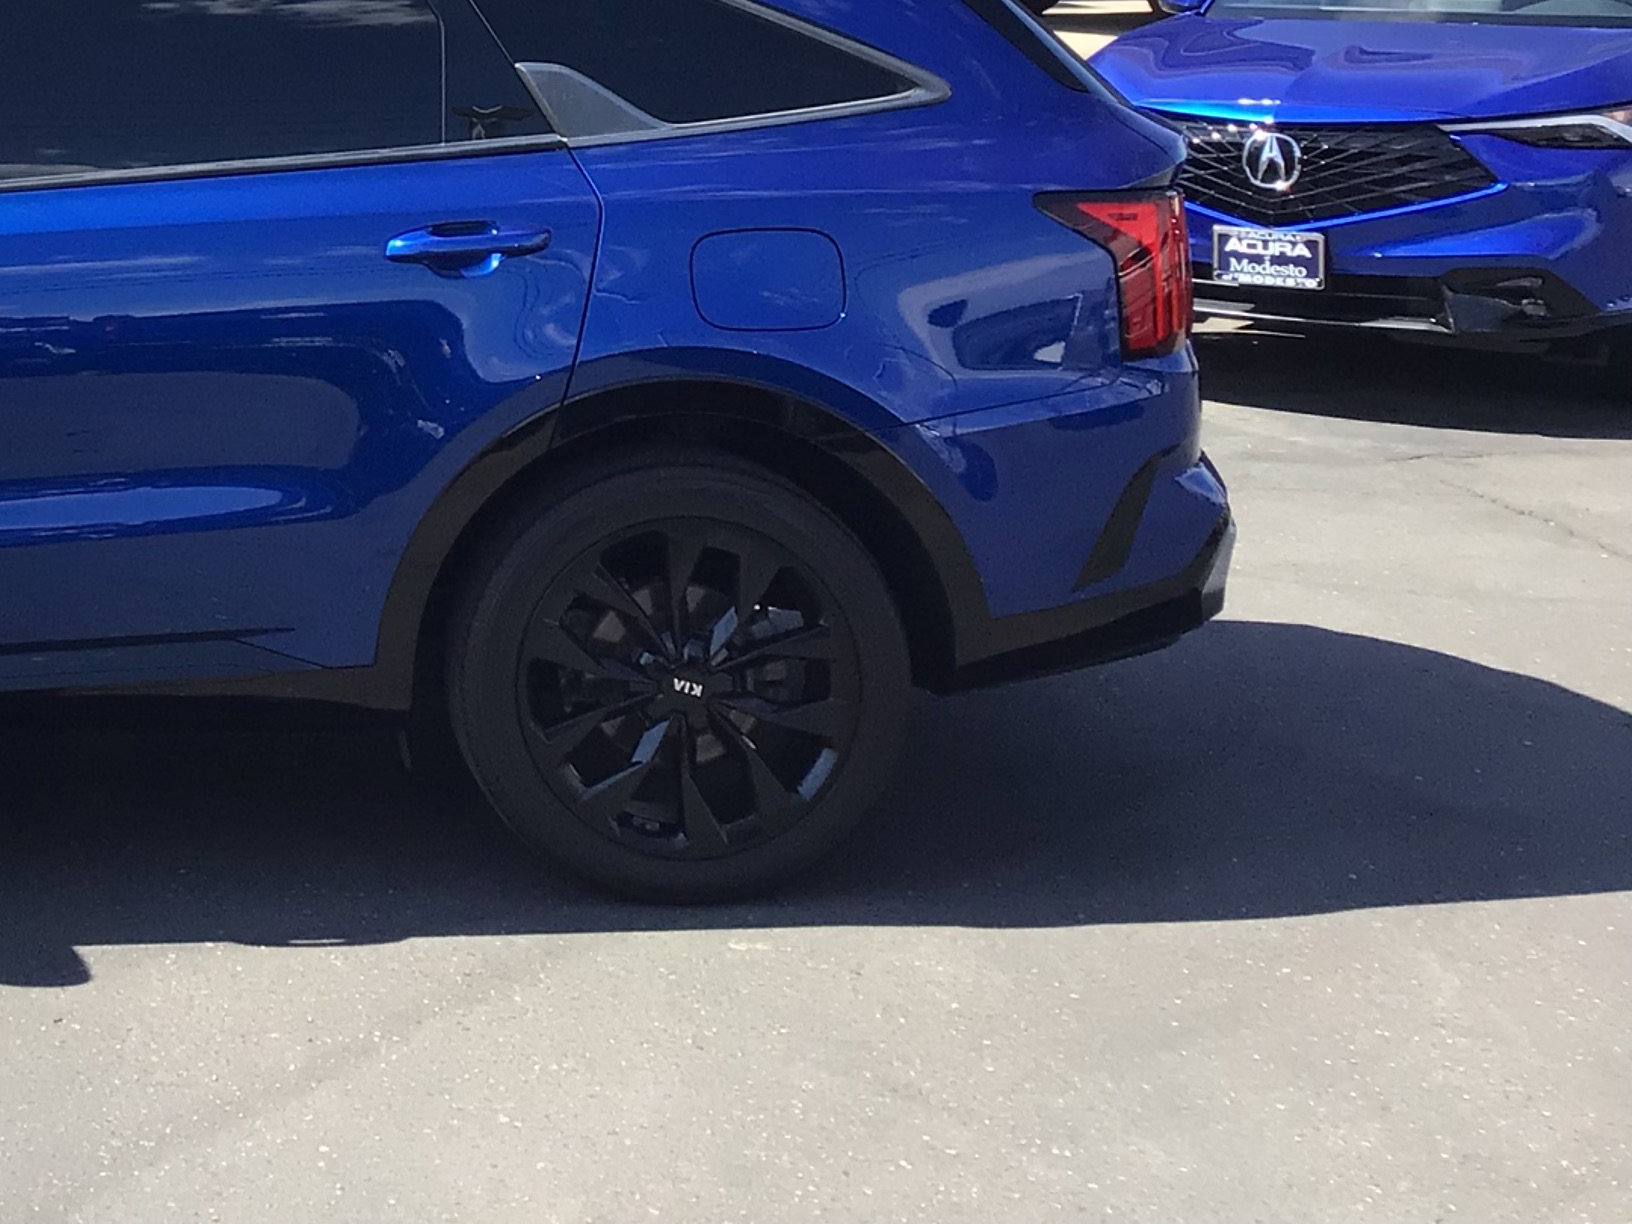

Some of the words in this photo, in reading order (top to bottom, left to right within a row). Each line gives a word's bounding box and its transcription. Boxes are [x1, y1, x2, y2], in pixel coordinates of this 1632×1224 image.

[1224, 236, 1312, 258] ACURA
[1228, 257, 1308, 278] Modesto
[673, 677, 703, 697] KIA
